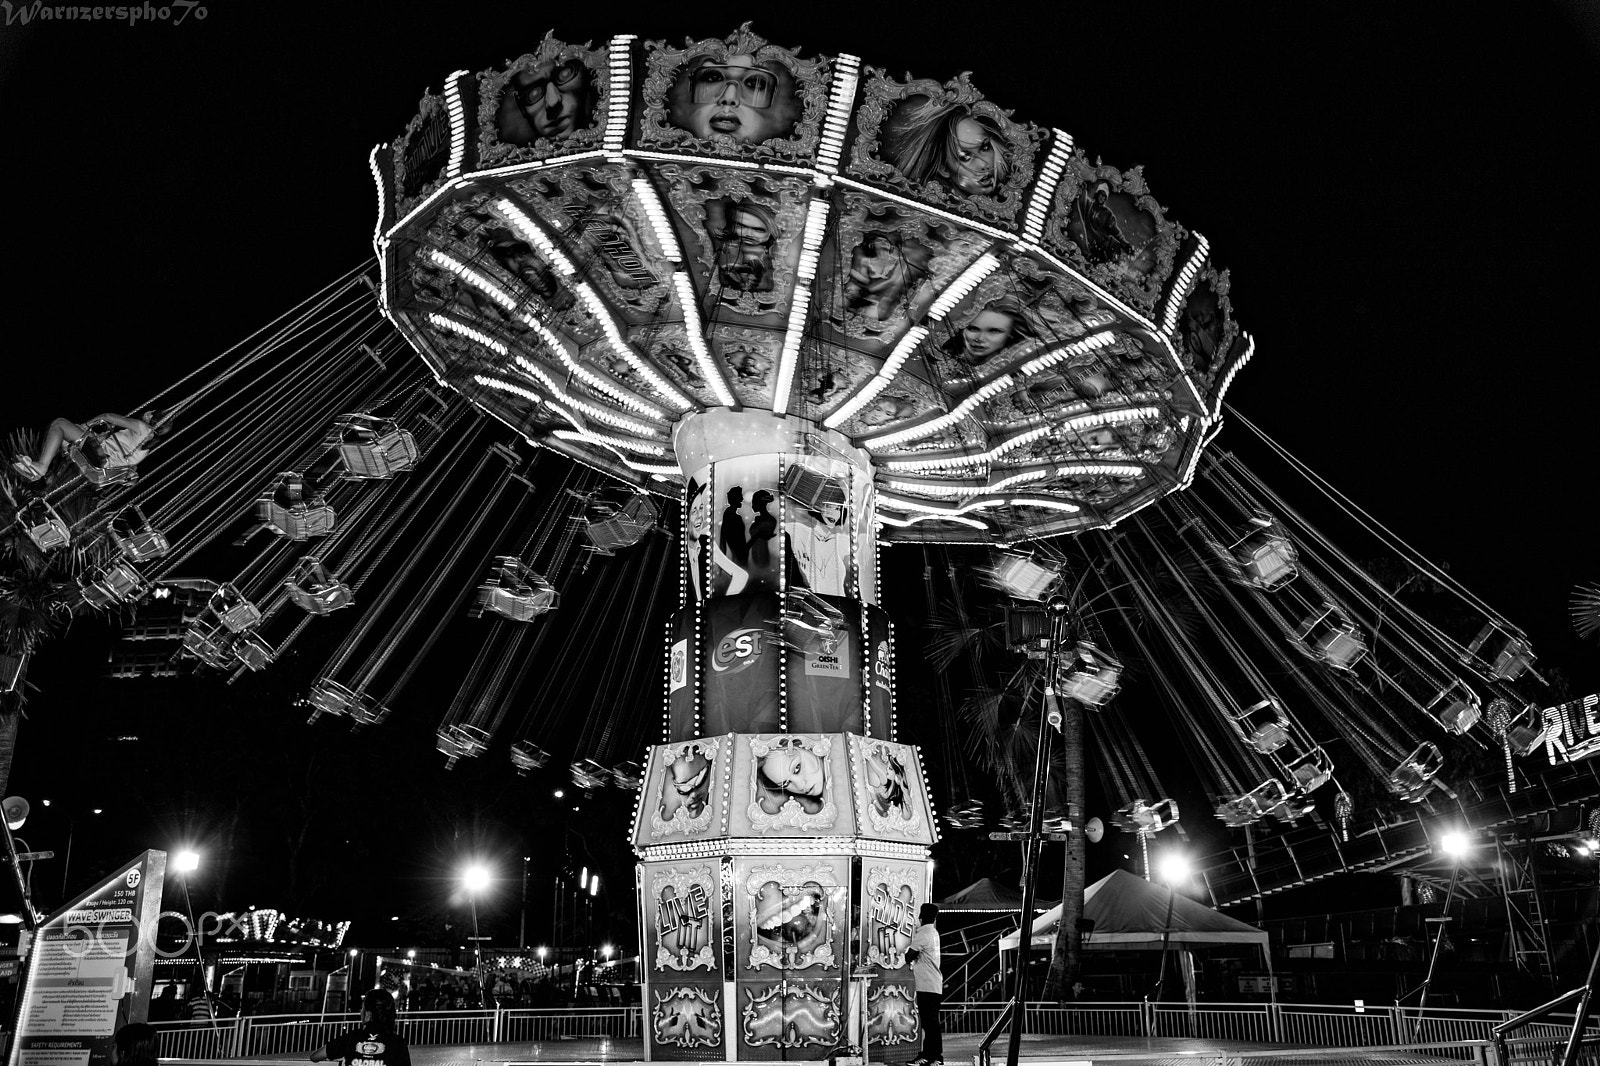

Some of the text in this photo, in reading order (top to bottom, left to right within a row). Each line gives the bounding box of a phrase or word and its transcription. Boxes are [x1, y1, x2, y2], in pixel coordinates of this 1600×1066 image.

[716, 631, 763, 664] est
[818, 655, 839, 664] OISHI
[1541, 693, 1600, 766] RIVE
[128, 873, 140, 885] 5F
[68, 910, 131, 922] WAVE SWINGER
[658, 886, 709, 936] LIVE
[870, 886, 915, 938] RIDE
